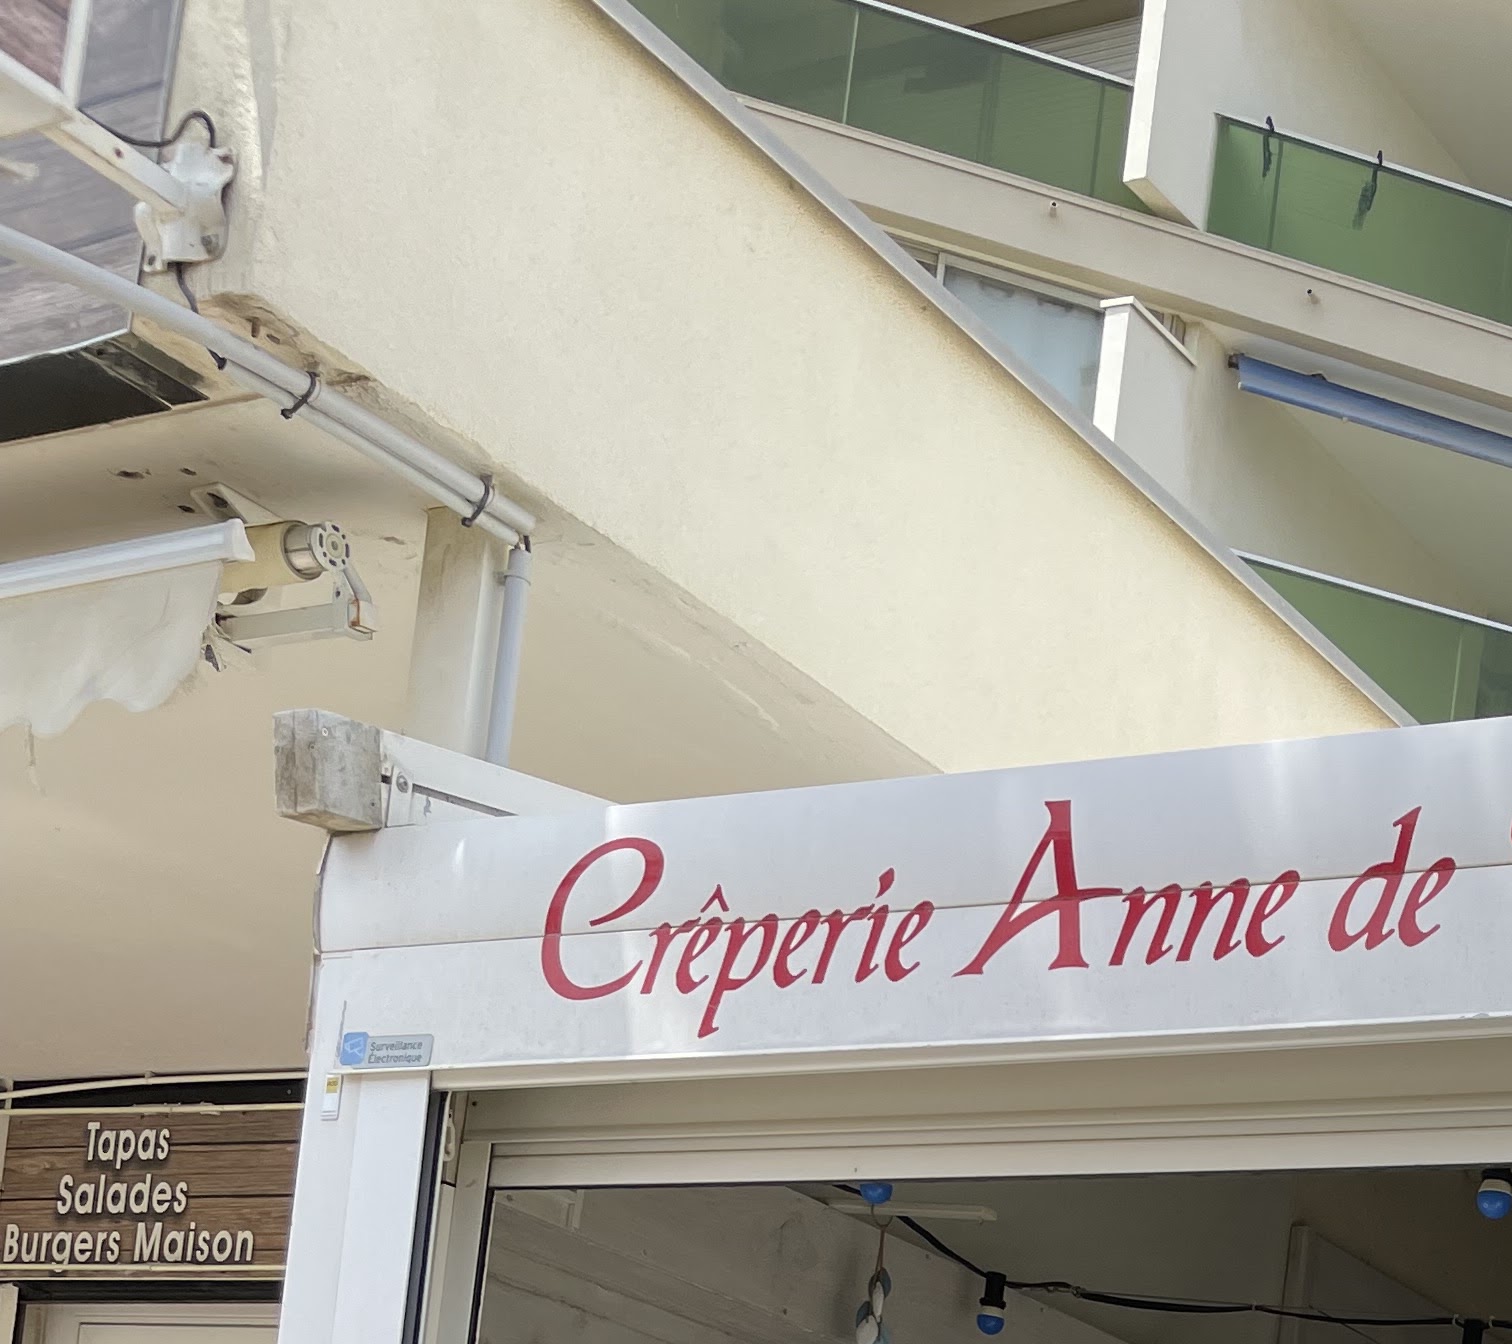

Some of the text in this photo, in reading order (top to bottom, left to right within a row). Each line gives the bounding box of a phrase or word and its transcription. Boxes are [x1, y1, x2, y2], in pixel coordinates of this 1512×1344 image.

[540, 837, 936, 1039] Crêperie
[952, 799, 1302, 978] Anne
[1328, 806, 1456, 953] de
[368, 1052, 422, 1064] Électronique
[370, 1041, 423, 1052] Surveillance
[86, 1121, 171, 1169] Tapas
[56, 1174, 188, 1214] Salades
[2, 1222, 254, 1272] Burgers Maison
